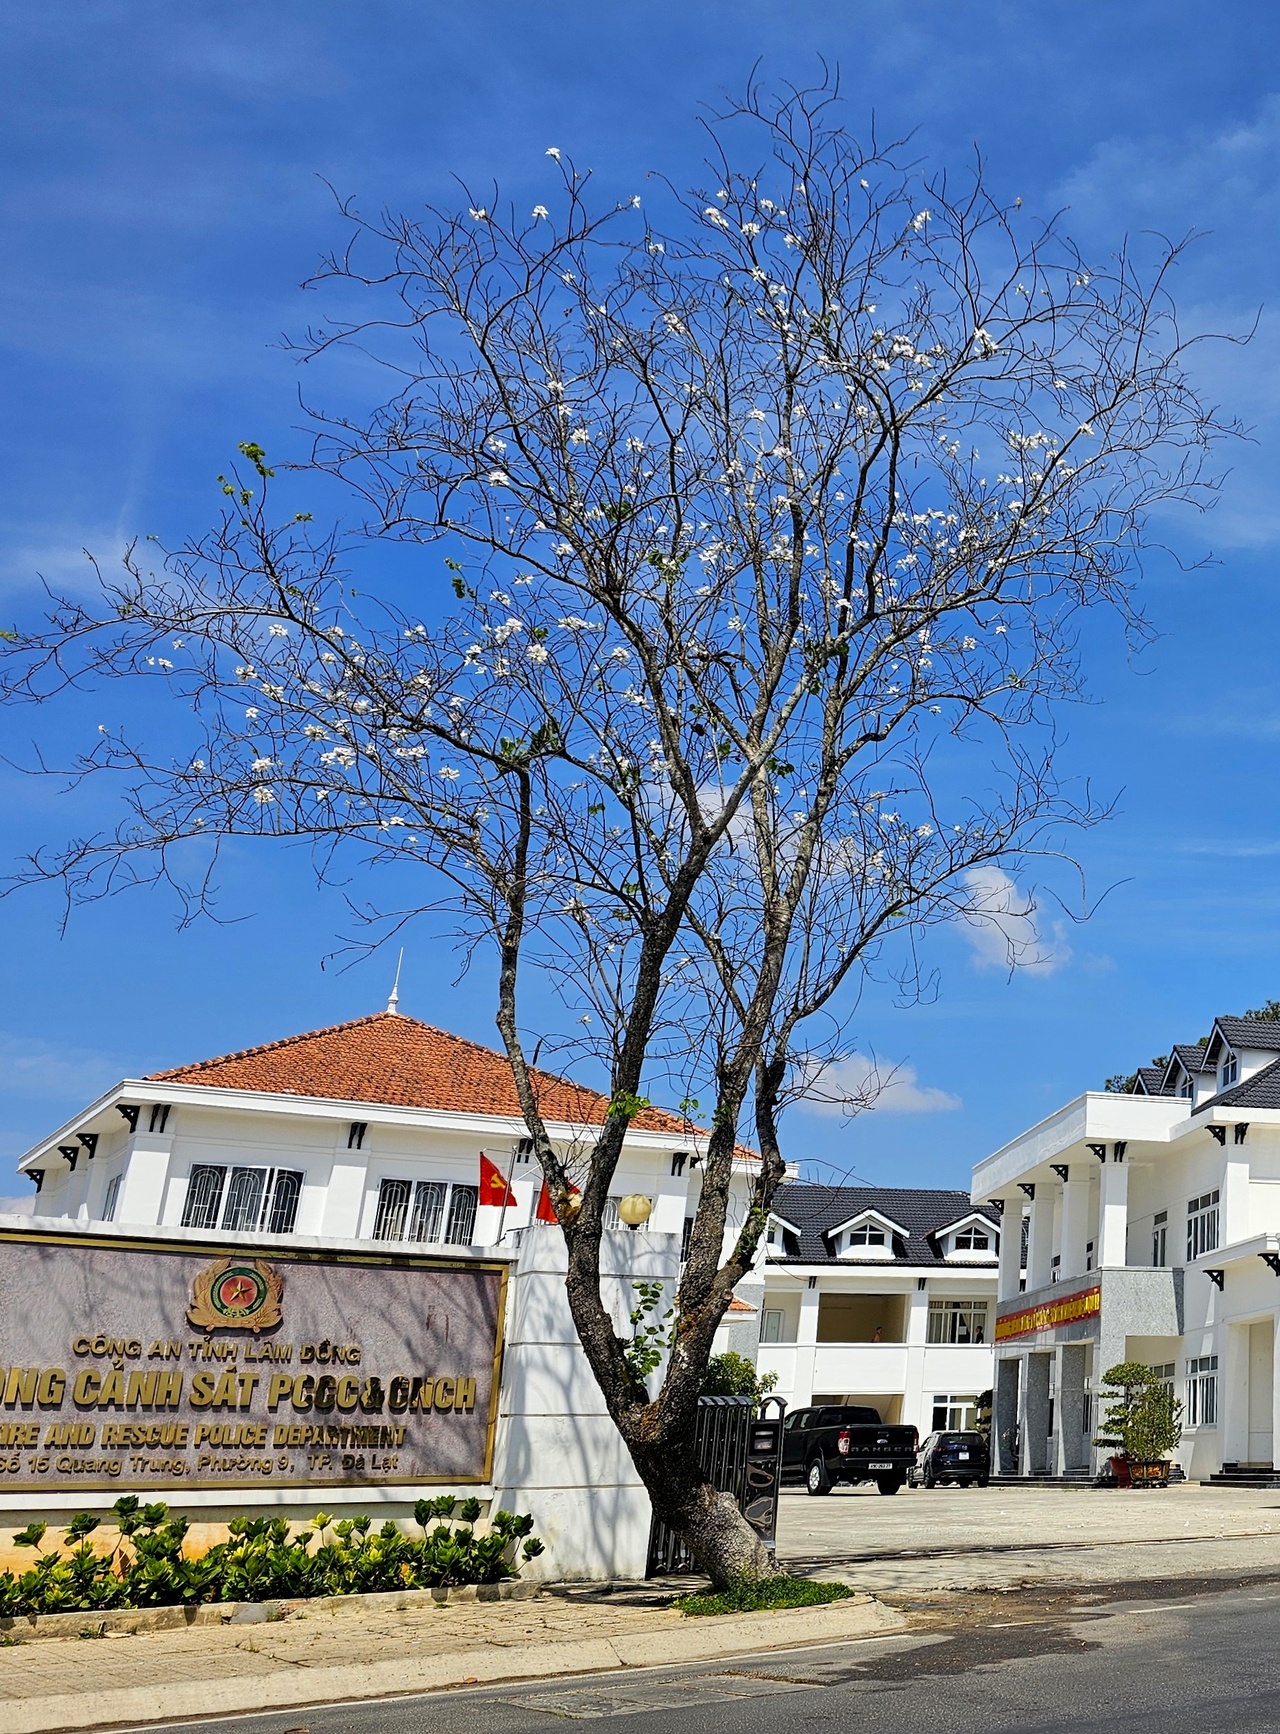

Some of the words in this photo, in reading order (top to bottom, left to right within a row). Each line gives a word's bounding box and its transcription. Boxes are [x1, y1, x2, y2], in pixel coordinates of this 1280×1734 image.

[73, 1335, 141, 1356] CÔNG
[148, 1340, 182, 1358] AN
[189, 1335, 238, 1359] TỈNH
[244, 1340, 292, 1360] LÂM
[300, 1338, 361, 1363] ĐỒNG
[73, 1357, 183, 1407] CẢNH
[190, 1365, 259, 1407] SÁT
[44, 1423, 96, 1446] AND
[101, 1424, 189, 1446] RESCUE
[194, 1424, 268, 1446] POLICE
[273, 1425, 407, 1447] DEPARTMENT
[28, 1455, 50, 1474] 15
[56, 1454, 122, 1475] Quang
[130, 1454, 190, 1475] Trung,
[198, 1454, 273, 1474] Phường
[277, 1454, 294, 1473] 9,
[307, 1455, 333, 1471] TP.
[342, 1453, 365, 1471] Đà
[371, 1454, 399, 1473] Lạt
